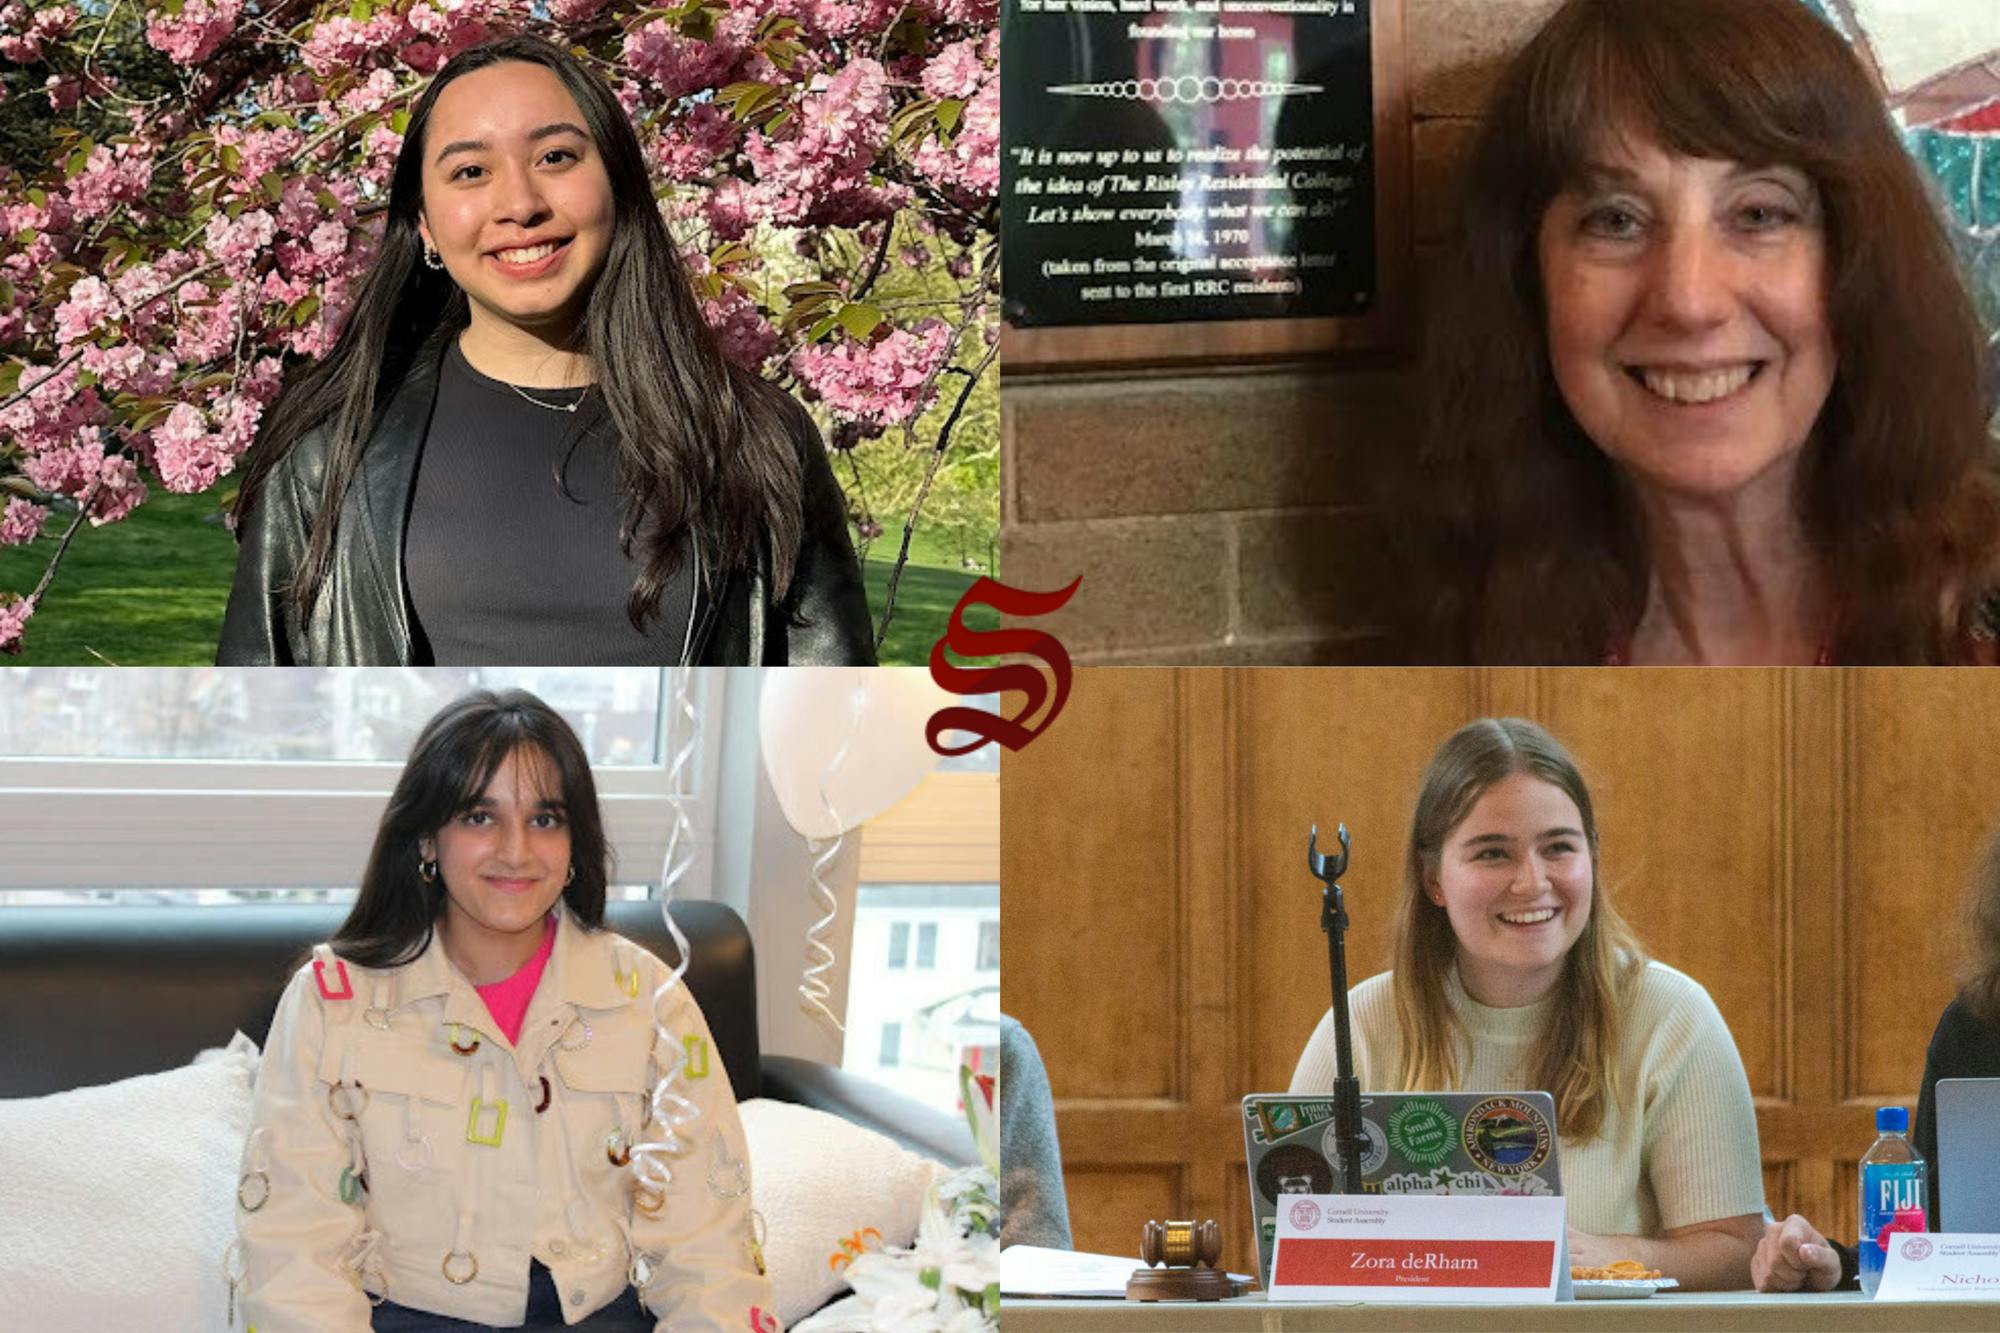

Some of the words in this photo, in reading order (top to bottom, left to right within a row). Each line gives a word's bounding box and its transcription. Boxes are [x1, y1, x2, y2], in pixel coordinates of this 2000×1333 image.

[1038, 148, 1052, 164] is
[1057, 151, 1092, 163] now
[1096, 151, 1120, 168] up
[1122, 149, 1140, 163] to
[1143, 150, 1162, 163] us
[1166, 149, 1183, 163] to
[1187, 145, 1241, 161] realize
[1245, 145, 1270, 160] the
[1272, 144, 1344, 165] potential
[1015, 176, 1042, 194] the
[1047, 176, 1084, 194] idea
[1086, 175, 1108, 197] of
[1110, 175, 1141, 192] The
[1144, 173, 1196, 194] Risley
[1200, 172, 1289, 190] Residential
[1027, 206, 1068, 223] Let's
[1072, 204, 1116, 222] show
[1119, 202, 1204, 225] everybody
[1207, 202, 1248, 218] what
[1251, 206, 1275, 218] we
[1277, 205, 1308, 218] can
[1214, 229, 1249, 244] 1970
[1041, 258, 1091, 279] (taken
[1093, 258, 1131, 274] from
[1133, 256, 1157, 272] the
[1159, 254, 1217, 274] original
[1219, 254, 1298, 272] acceptance
[1080, 285, 1112, 300] sent
[1115, 285, 1131, 298] to
[1134, 282, 1157, 298] the
[1160, 281, 1191, 297] first
[1194, 279, 1230, 295] RRC
[1404, 1116, 1437, 1135] Small
[1465, 1099, 1507, 1151] ADIRONDACK
[1509, 1100, 1549, 1150] MOUNTAINS
[1407, 1128, 1443, 1147] Farms
[1386, 1177, 1433, 1193] alpha
[1455, 1174, 1481, 1189] chi
[1880, 1179, 1920, 1211] FIJI
[1327, 1207, 1352, 1216] Cornell
[1353, 1207, 1389, 1217] University
[1327, 1217, 1352, 1225] Student
[1353, 1217, 1386, 1226] Assembly
[1350, 1251, 1396, 1269] Zora
[1401, 1251, 1479, 1270] deRham
[1395, 1275, 1431, 1283] President
